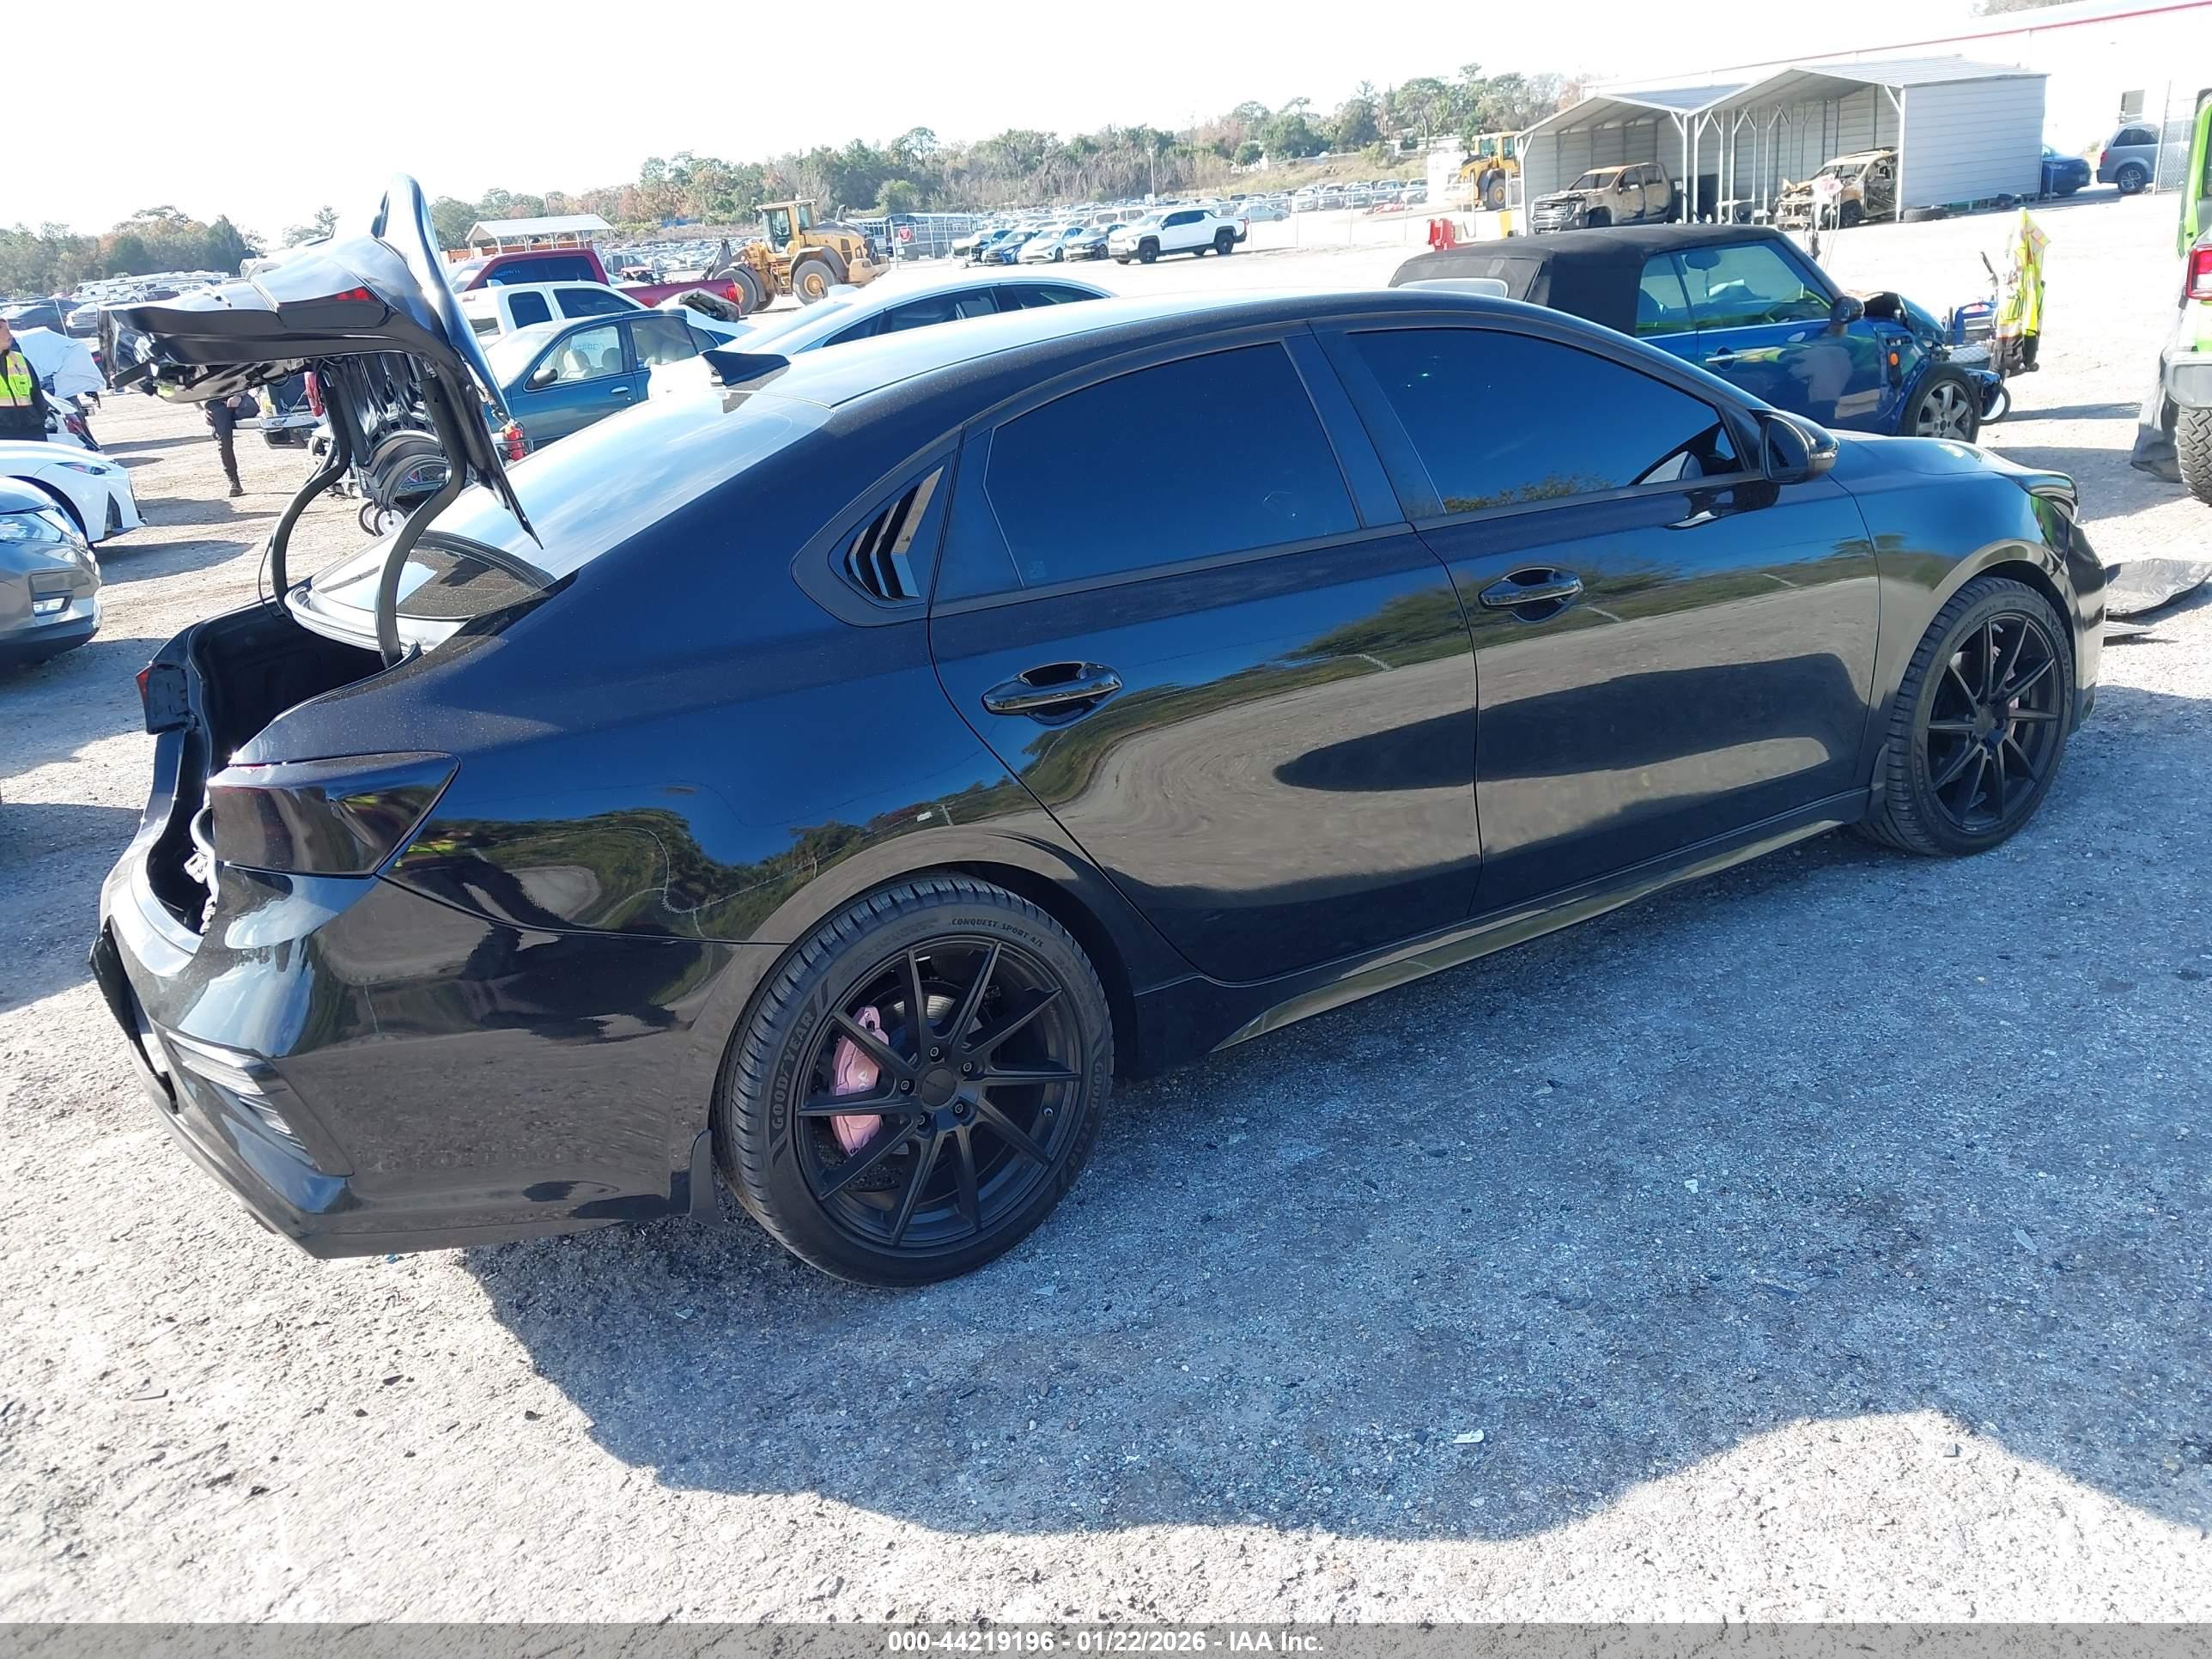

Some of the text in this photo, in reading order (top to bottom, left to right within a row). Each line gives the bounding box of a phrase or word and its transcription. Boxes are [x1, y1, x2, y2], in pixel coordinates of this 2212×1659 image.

[951, 917, 1044, 948] CONQUEST SPORT A/S
